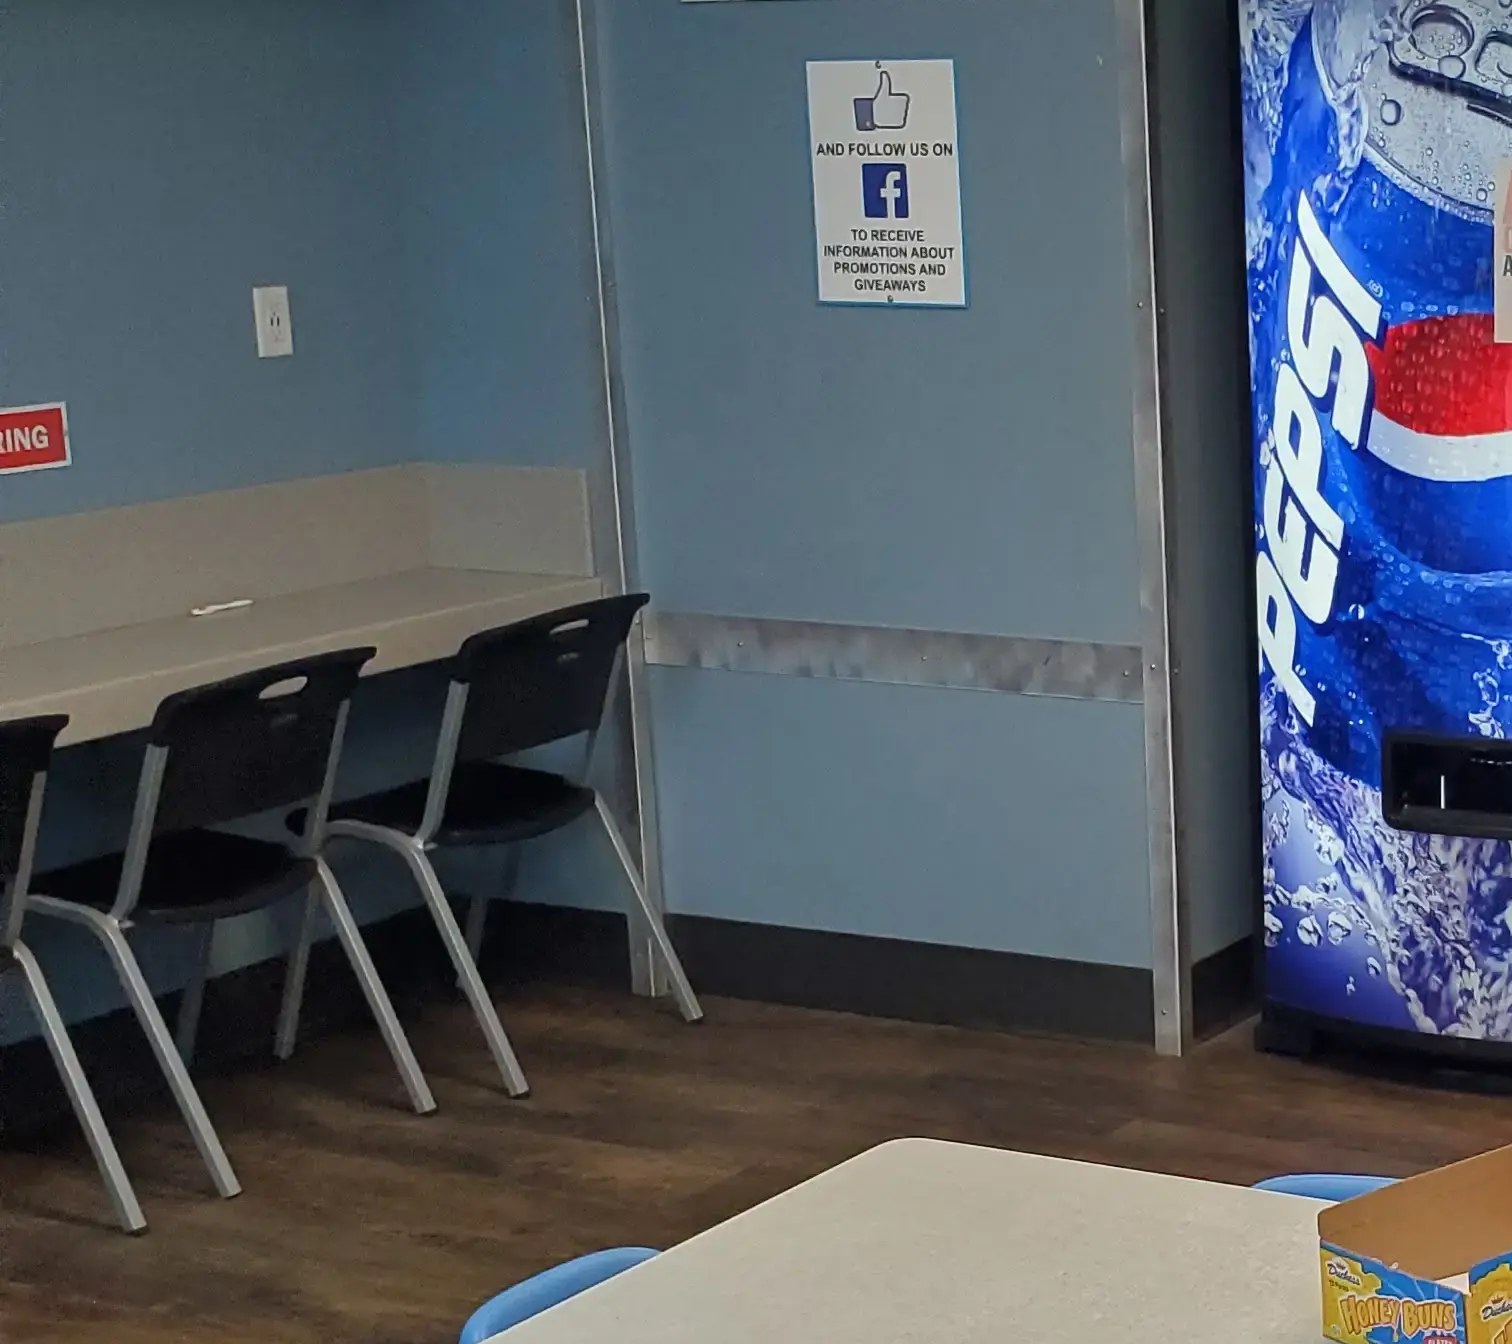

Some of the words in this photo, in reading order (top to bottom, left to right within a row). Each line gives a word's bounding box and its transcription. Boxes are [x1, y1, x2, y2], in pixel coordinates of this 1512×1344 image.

[817, 144, 845, 157] AND
[848, 143, 906, 157] FOLLOW
[910, 143, 929, 157] US
[932, 143, 953, 156] ON
[850, 229, 867, 241] TO
[871, 229, 925, 242] RECEIVE
[824, 245, 907, 258] INFORMATION
[911, 246, 954, 259] ABOUT
[833, 263, 916, 276] PROMOTIONS
[919, 263, 946, 276] AND
[854, 279, 926, 292] GIVEAWAYS
[1256, 188, 1383, 729] PEPSI
[1340, 1294, 1400, 1335] HONEY
[1402, 1301, 1456, 1337] BUNS
